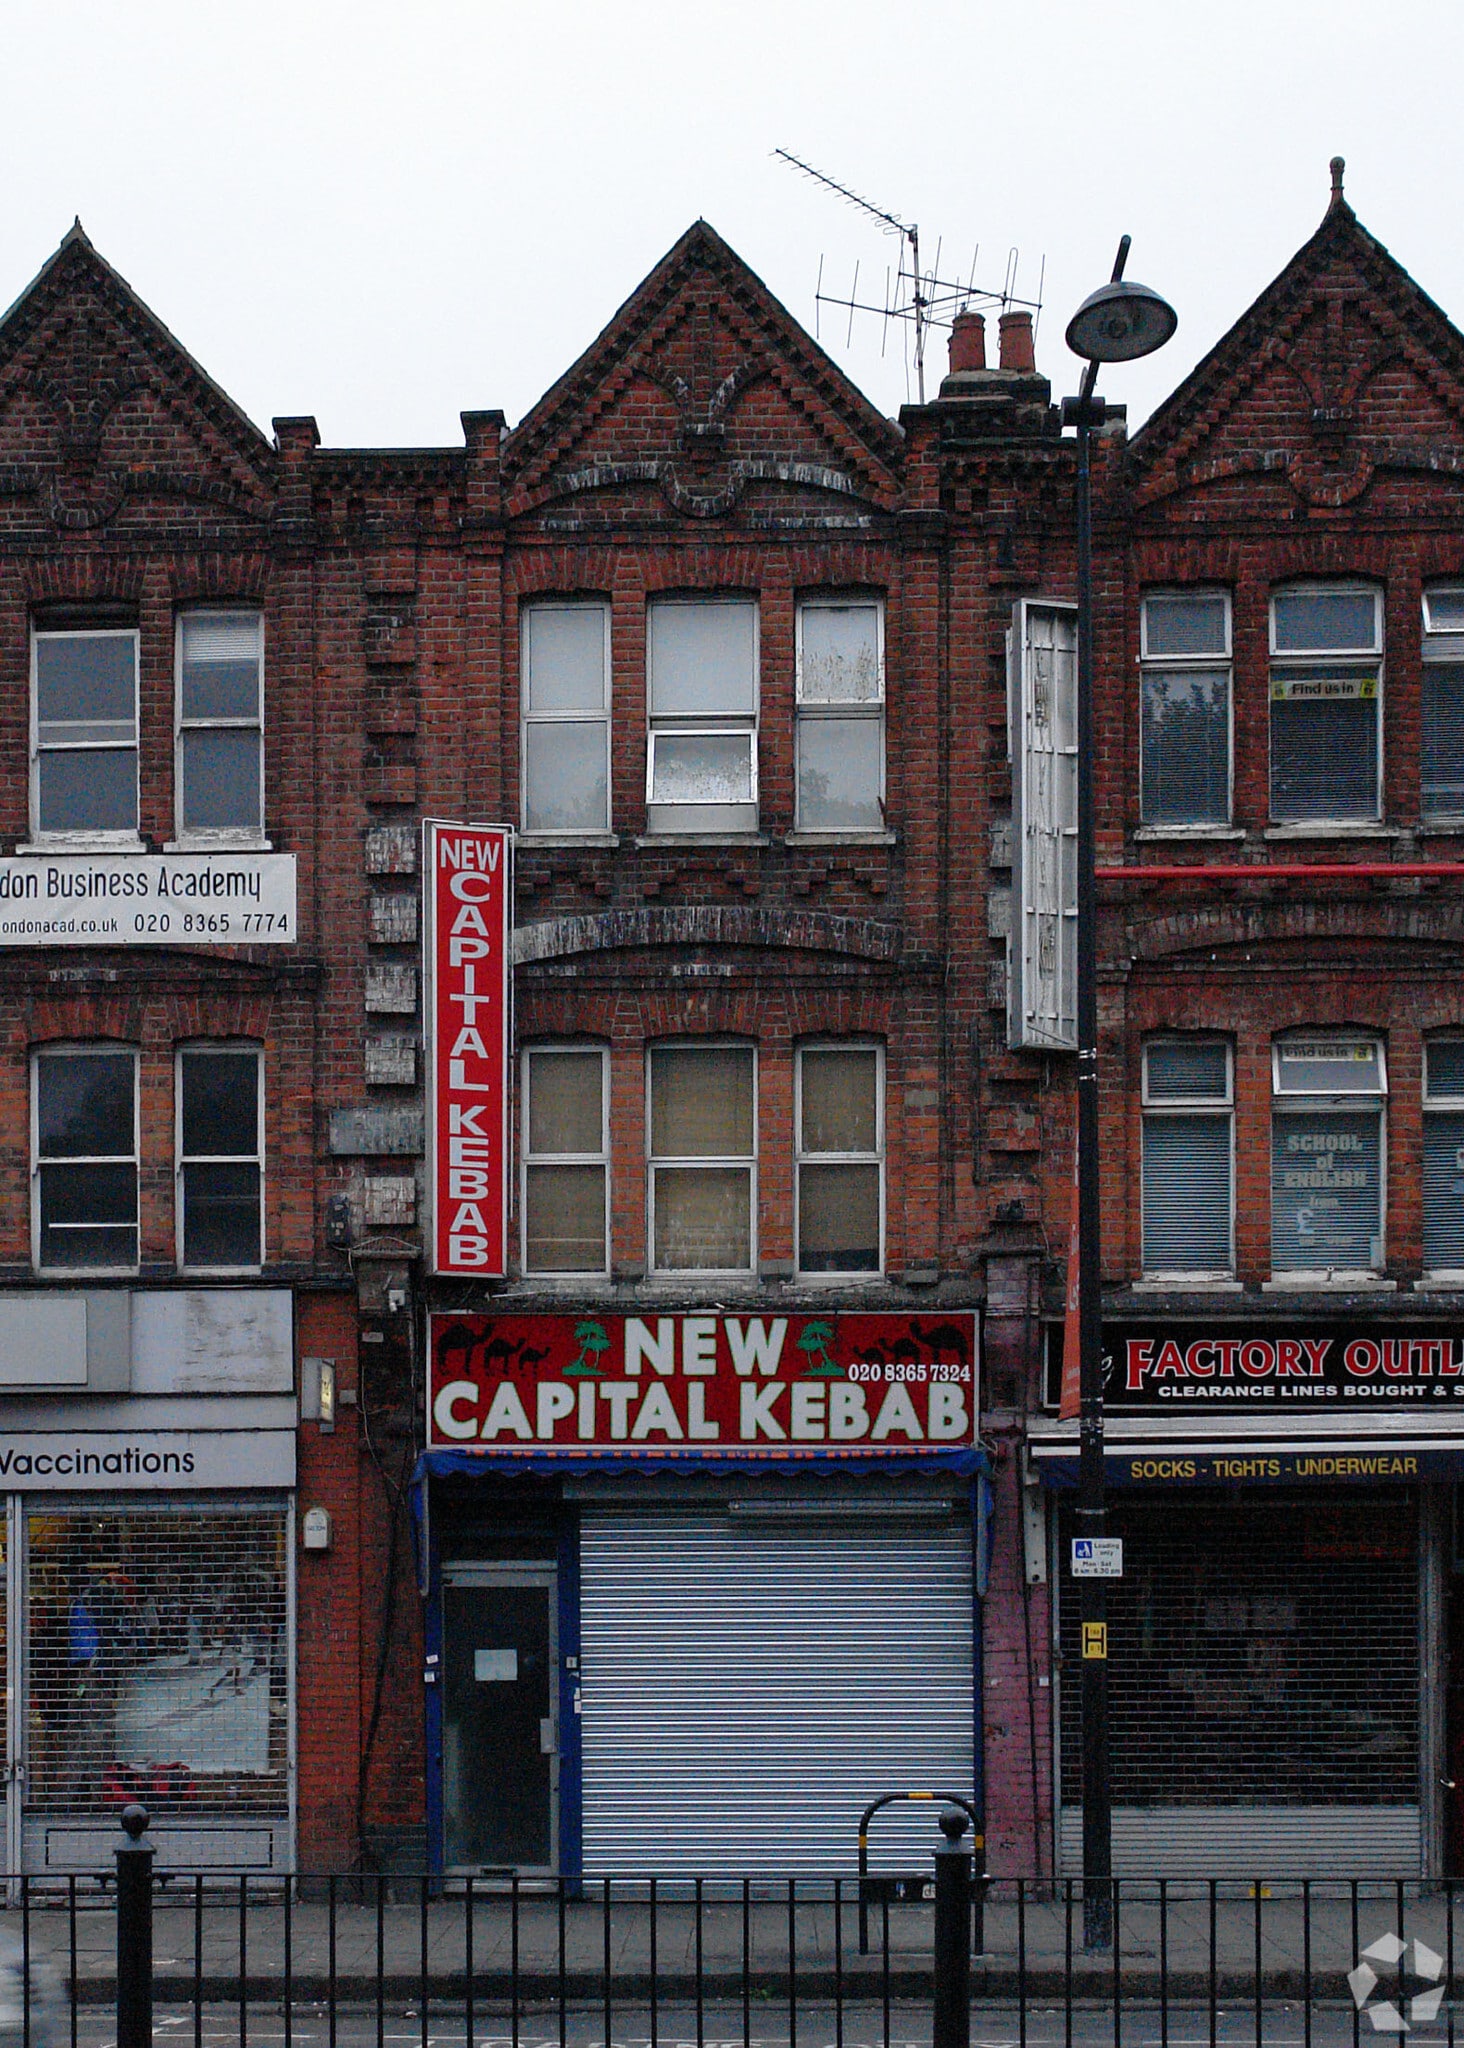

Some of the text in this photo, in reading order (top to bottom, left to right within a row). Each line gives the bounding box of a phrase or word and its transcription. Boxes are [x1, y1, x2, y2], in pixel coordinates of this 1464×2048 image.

[1292, 682, 1320, 694] Find
[1324, 685, 1339, 694] us
[1342, 682, 1354, 694] in
[441, 838, 500, 872] NEW
[47, 867, 149, 897] Business
[158, 866, 261, 902] Academy
[134, 914, 170, 932] 020
[183, 913, 230, 932] 8365
[242, 913, 288, 932] 7774
[449, 871, 490, 1266] CAPITAL KEBAB
[1287, 1134, 1363, 1150] SCHOOL
[1316, 1152, 1333, 1169] of
[1284, 1171, 1367, 1187] ENGLISH
[624, 1317, 788, 1376] NEW
[848, 1363, 971, 1382] 020 8365 7324
[1125, 1339, 1334, 1390] FACTORY
[1344, 1338, 1464, 1377] OUTL
[1158, 1386, 1275, 1398] CLEARANCE
[1281, 1385, 1338, 1397] LINES
[1343, 1385, 1427, 1397] BOUGHT
[1433, 1385, 1447, 1397] &
[433, 1380, 970, 1440] CAPITAL KEBAB
[1131, 1460, 1196, 1479] SOCKS
[1212, 1459, 1280, 1478] TIGHTS
[1296, 1457, 1418, 1476] UNDERWEAR
